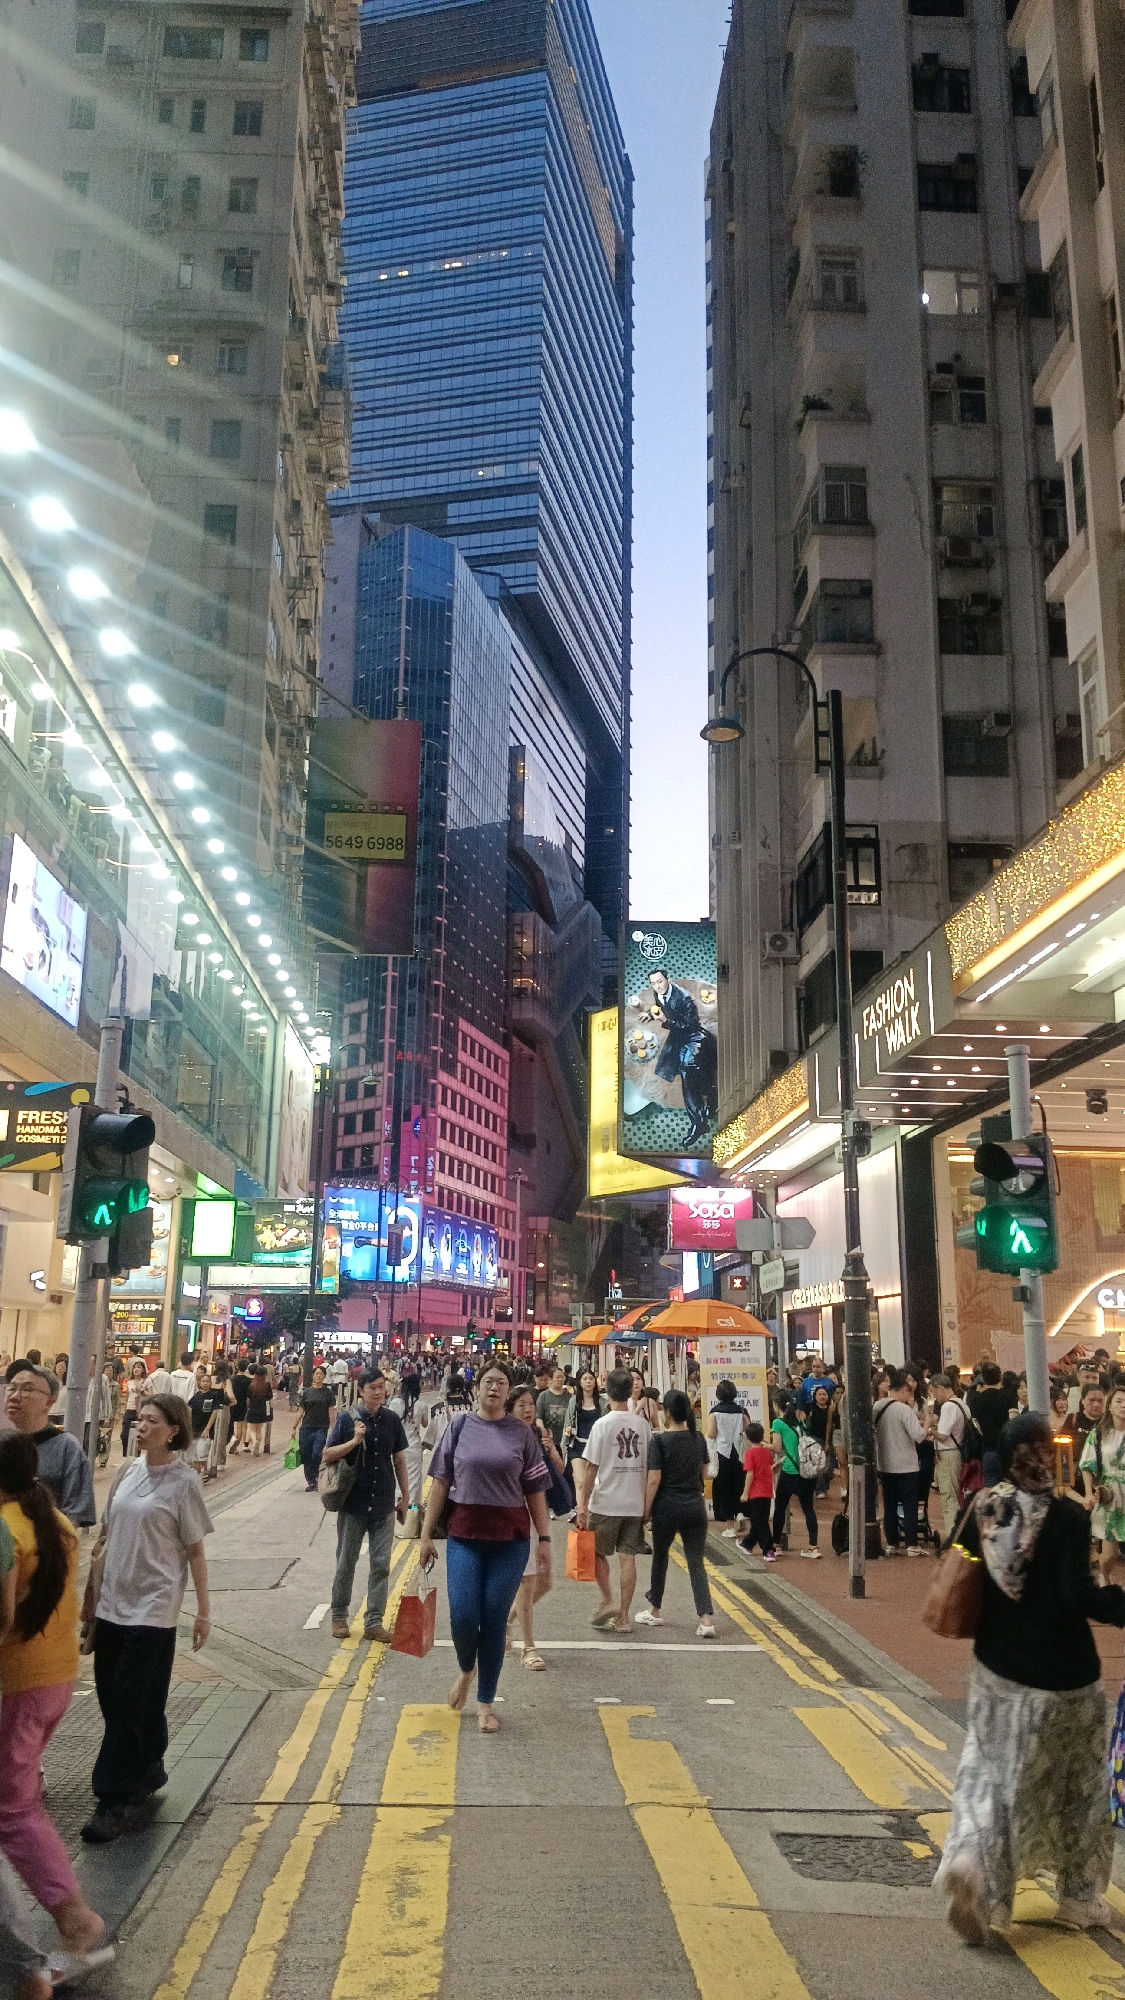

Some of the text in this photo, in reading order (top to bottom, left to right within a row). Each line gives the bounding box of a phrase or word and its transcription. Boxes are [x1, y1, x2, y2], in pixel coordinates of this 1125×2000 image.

[325, 835, 404, 851] 5649 6988
[862, 967, 915, 1041] FASHION
[884, 1001, 921, 1056] WALK
